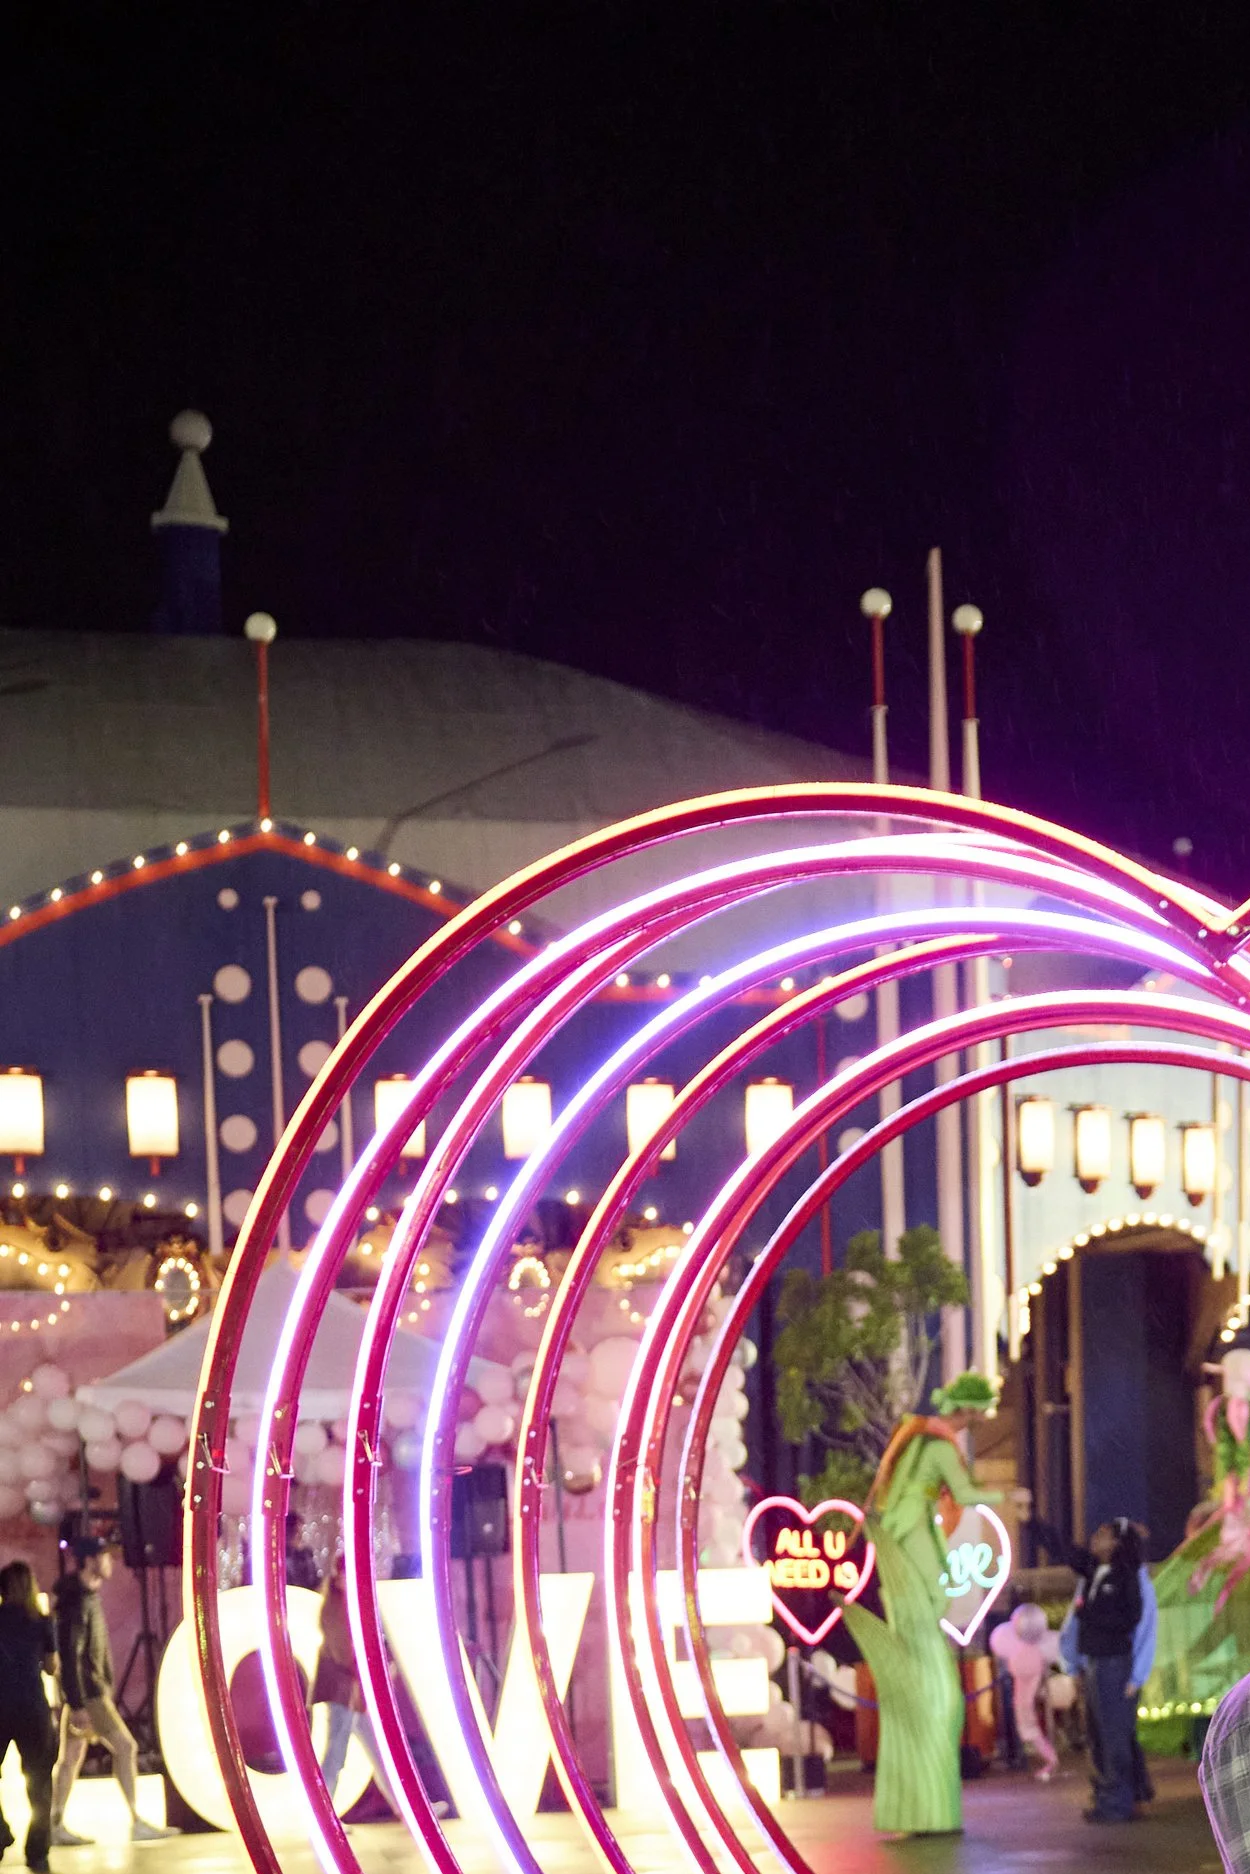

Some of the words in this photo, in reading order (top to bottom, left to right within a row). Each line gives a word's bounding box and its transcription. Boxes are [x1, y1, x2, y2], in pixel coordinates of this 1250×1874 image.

[776, 1527, 820, 1558] ALL
[824, 1531, 846, 1560] U
[765, 1558, 830, 1588] NEED
[835, 1561, 858, 1589] IS
[939, 1542, 1003, 1597] ve
